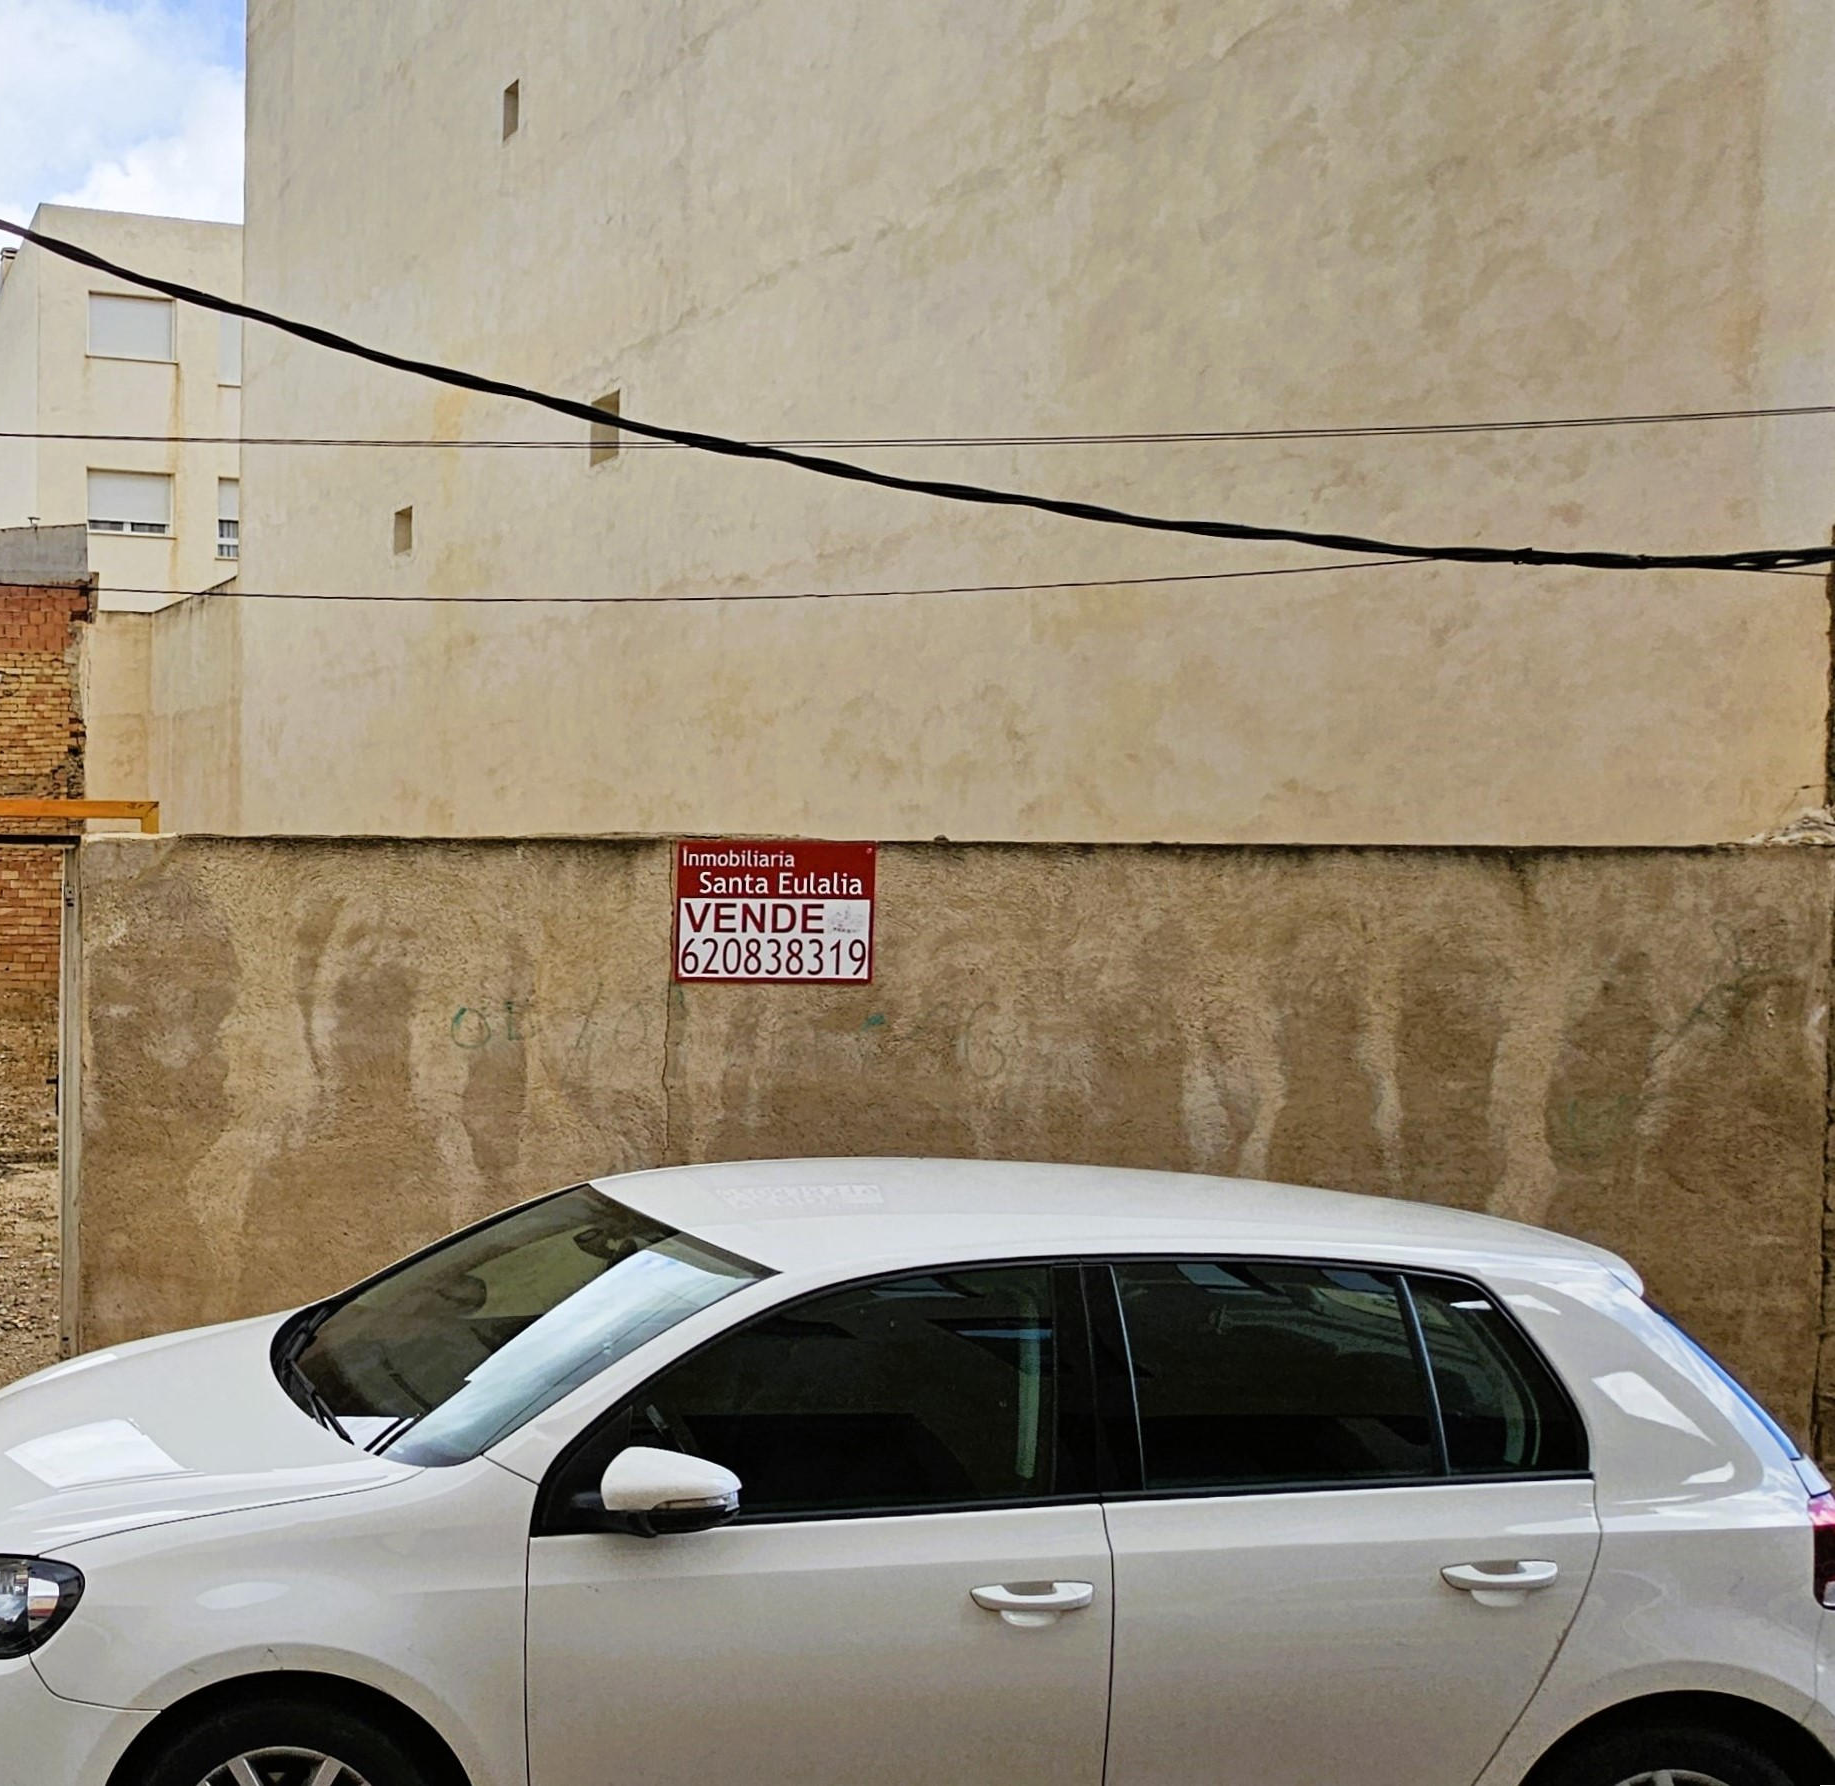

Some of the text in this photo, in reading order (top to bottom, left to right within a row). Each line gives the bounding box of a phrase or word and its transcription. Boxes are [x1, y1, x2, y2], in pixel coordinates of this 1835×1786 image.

[682, 848, 796, 868] Inmobiliaria
[699, 871, 863, 895] Santa Eulalia
[684, 902, 825, 934] VENDE
[681, 937, 866, 976] 620838319
